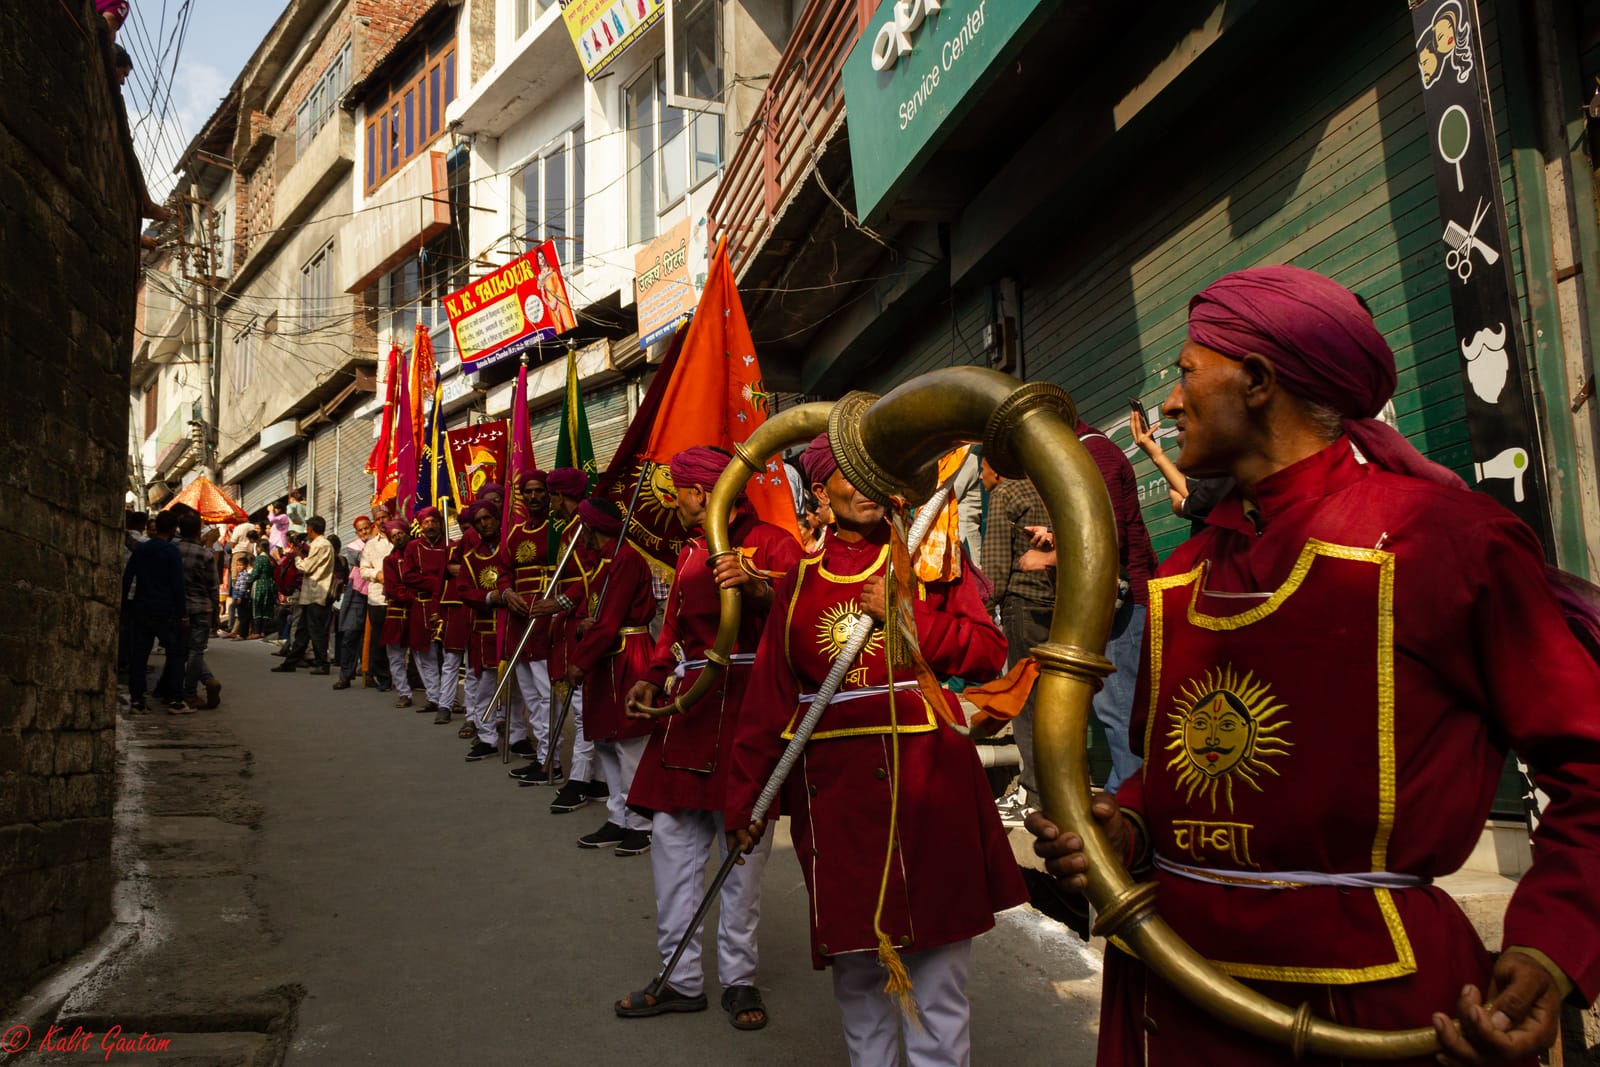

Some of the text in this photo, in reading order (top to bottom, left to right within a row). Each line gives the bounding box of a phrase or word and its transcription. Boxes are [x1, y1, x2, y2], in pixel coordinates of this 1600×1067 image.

[899, 0, 986, 130] Service Center
[446, 298, 462, 319] N.
[460, 291, 477, 313] K.
[475, 259, 535, 304] TAILOUR
